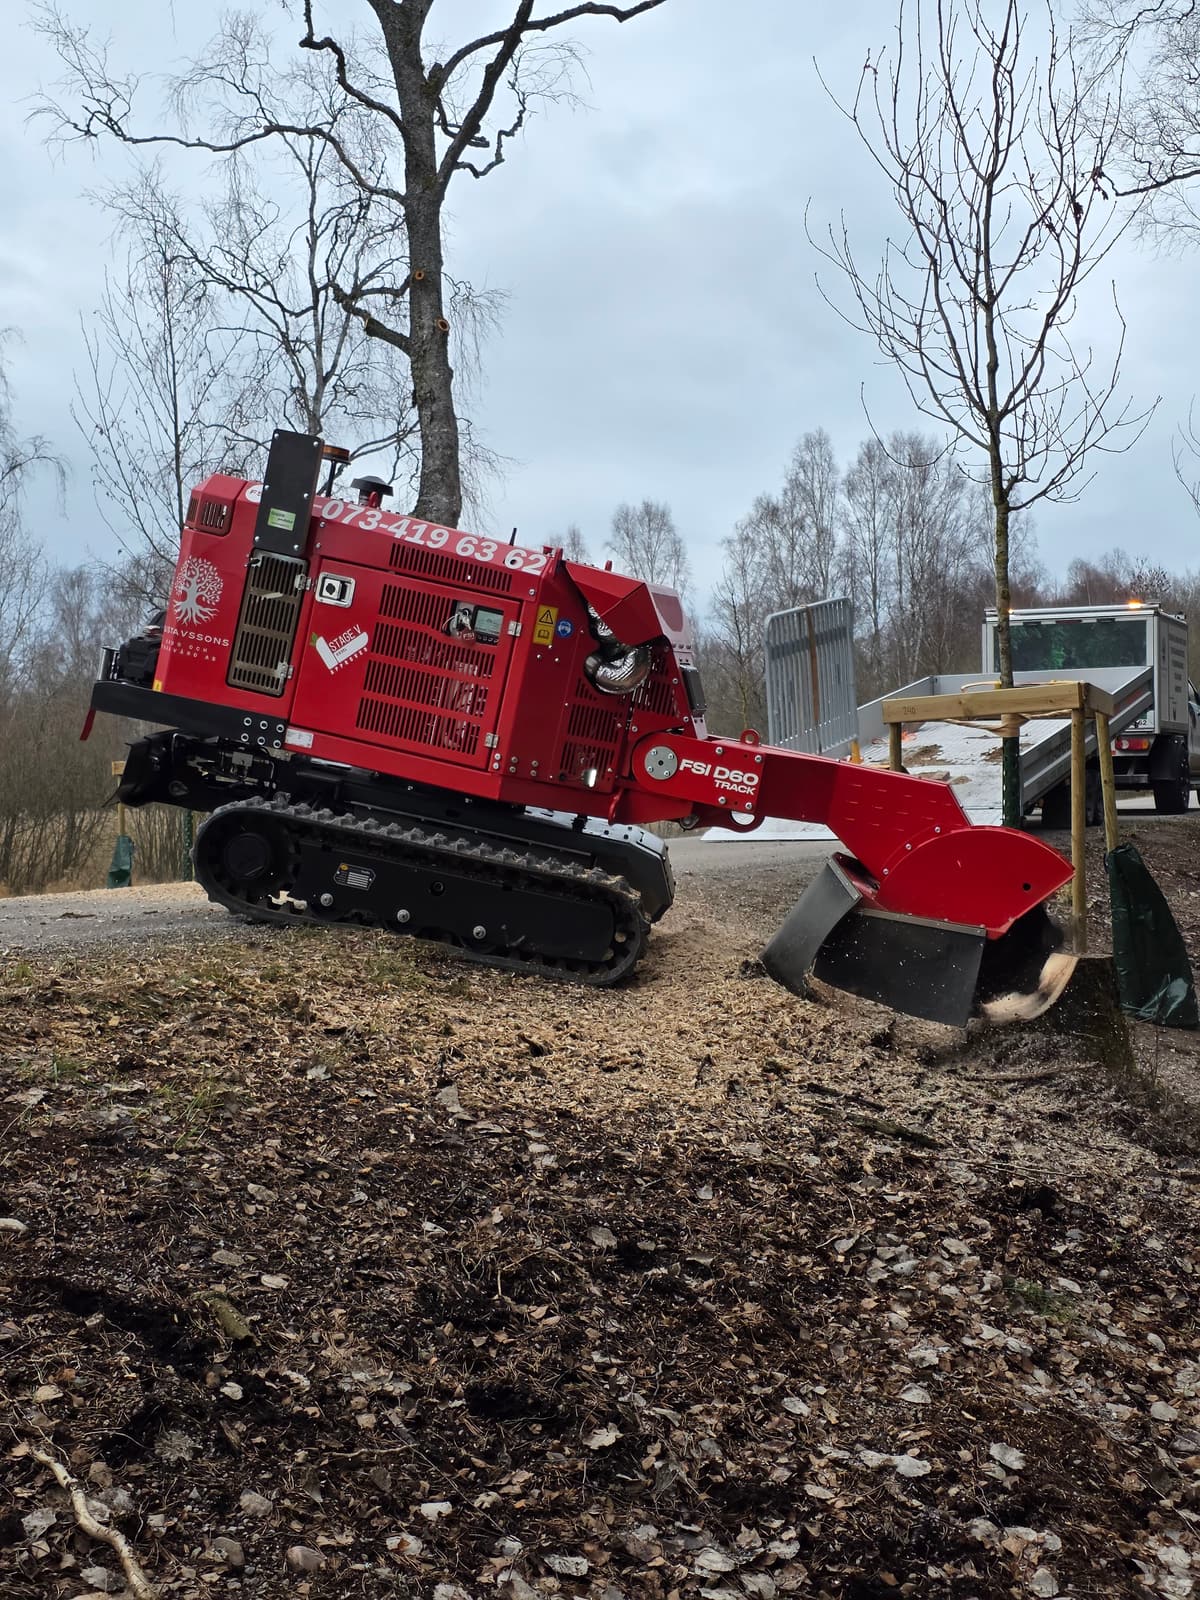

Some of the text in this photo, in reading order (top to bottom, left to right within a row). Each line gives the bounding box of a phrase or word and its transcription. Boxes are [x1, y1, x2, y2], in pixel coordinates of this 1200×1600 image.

[455, 536, 498, 562] 63
[505, 549, 548, 576] 62
[328, 628, 356, 652] STAGE
[353, 624, 361, 634] V
[679, 758, 759, 786] FSI D60
[714, 779, 757, 796] TRACK
